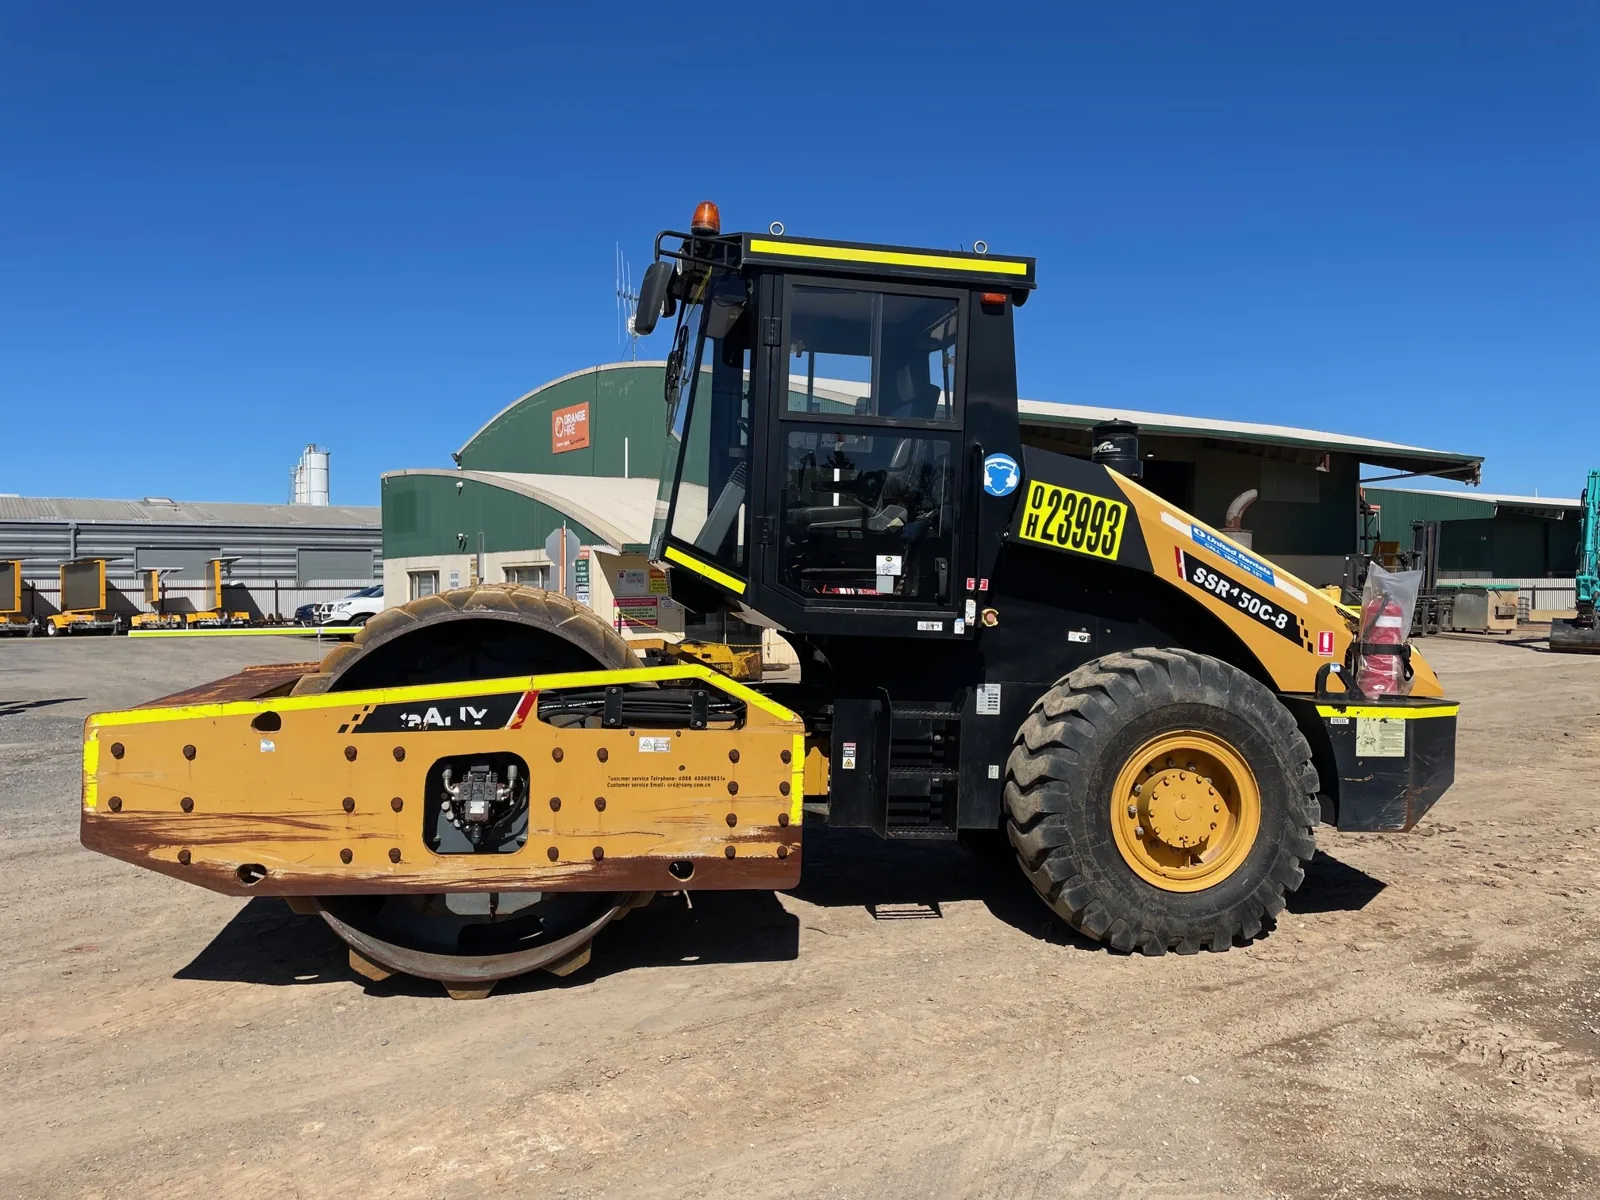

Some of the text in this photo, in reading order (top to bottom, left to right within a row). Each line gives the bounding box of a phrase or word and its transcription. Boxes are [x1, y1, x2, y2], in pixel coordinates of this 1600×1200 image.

[1040, 489, 1121, 556] 23993
[1207, 535, 1272, 576] United Rentals
